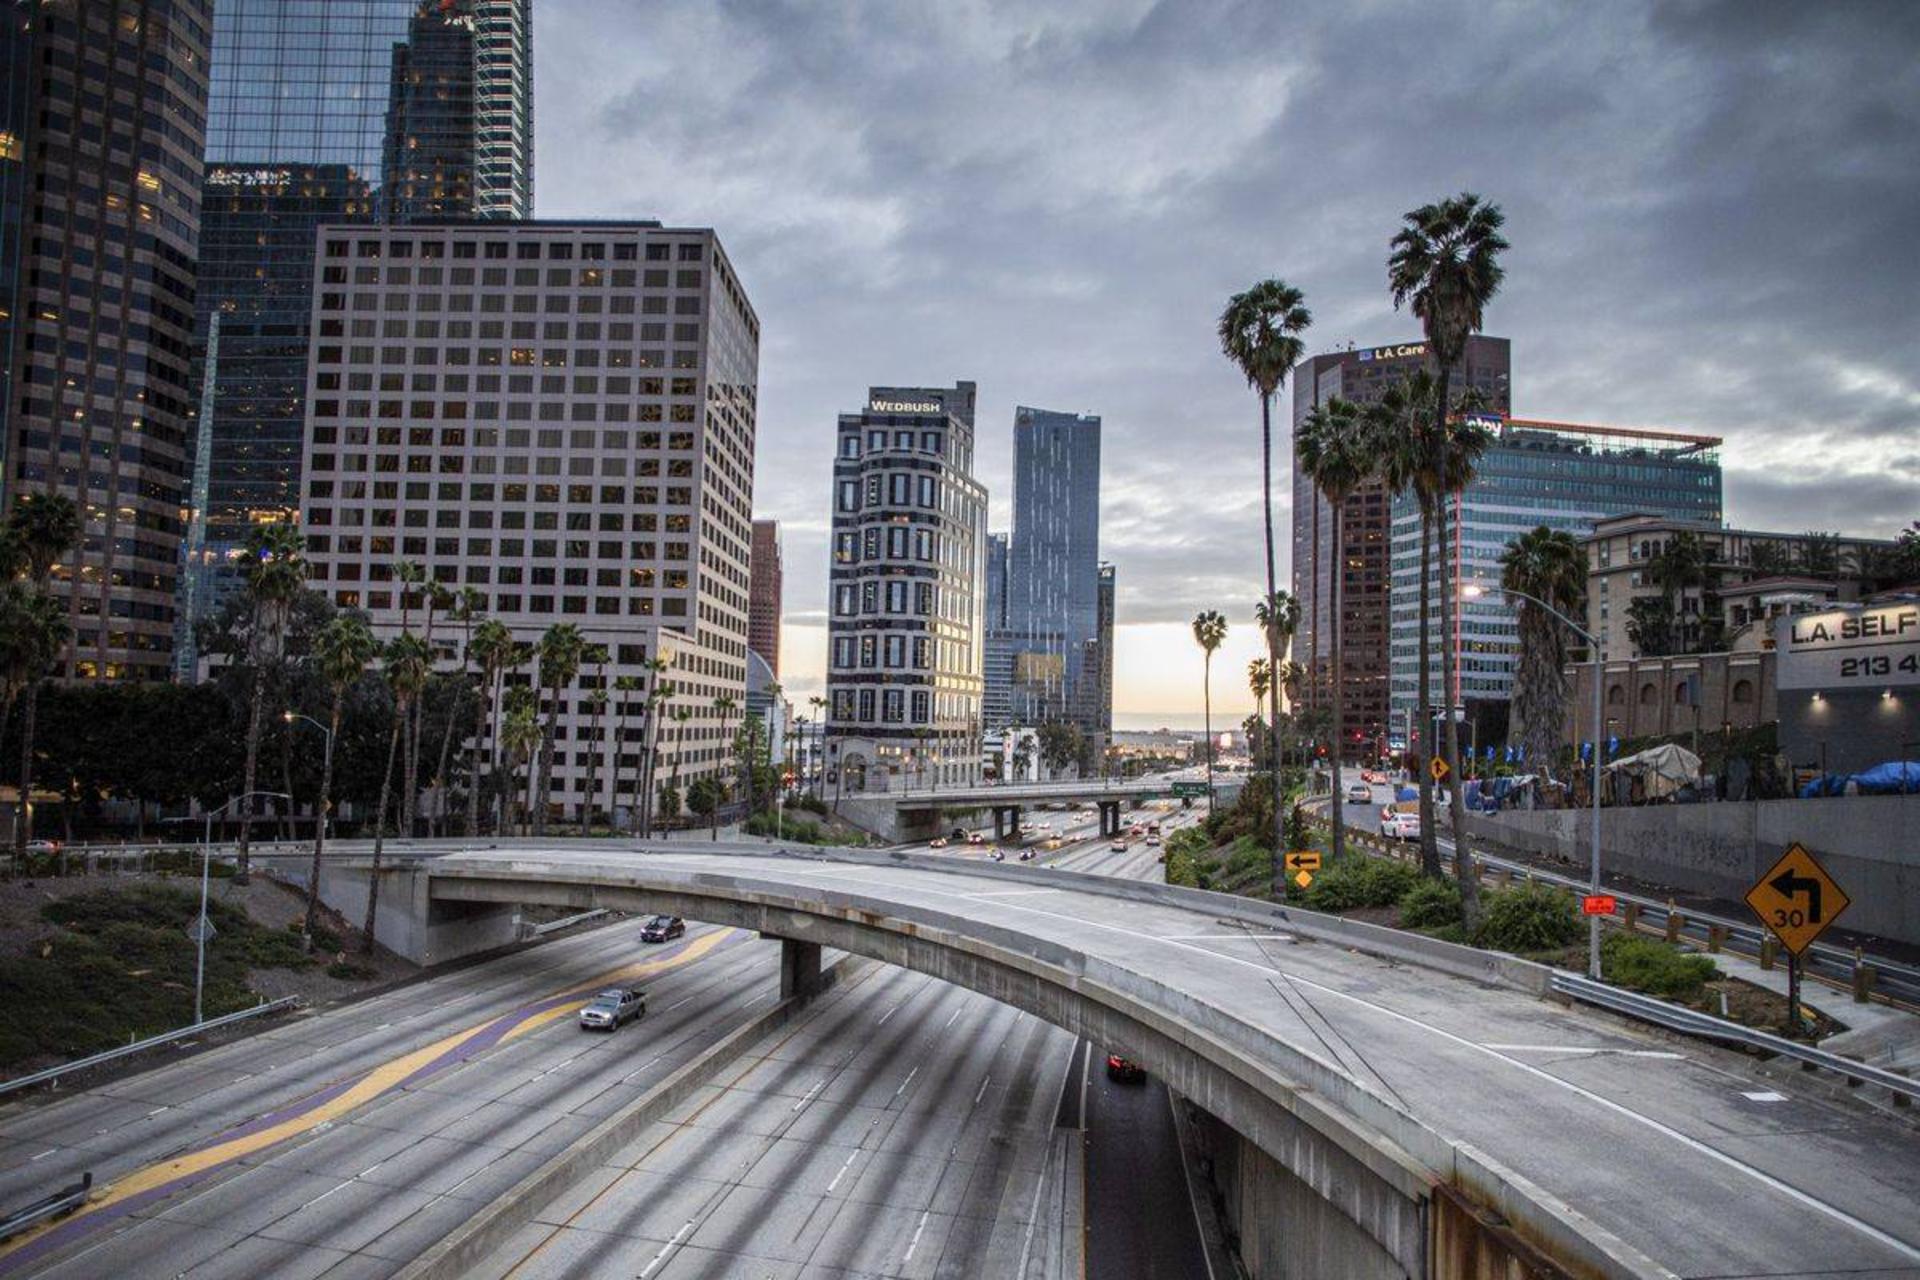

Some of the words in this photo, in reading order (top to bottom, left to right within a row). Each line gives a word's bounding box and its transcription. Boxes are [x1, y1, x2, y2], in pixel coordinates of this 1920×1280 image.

[1397, 345, 1425, 357] Care
[1791, 622, 1835, 644] L.A.
[1841, 611, 1917, 639] SELF
[1841, 656, 1890, 677] 213
[1898, 654, 1920, 673] 4
[1774, 909, 1804, 928] 30
